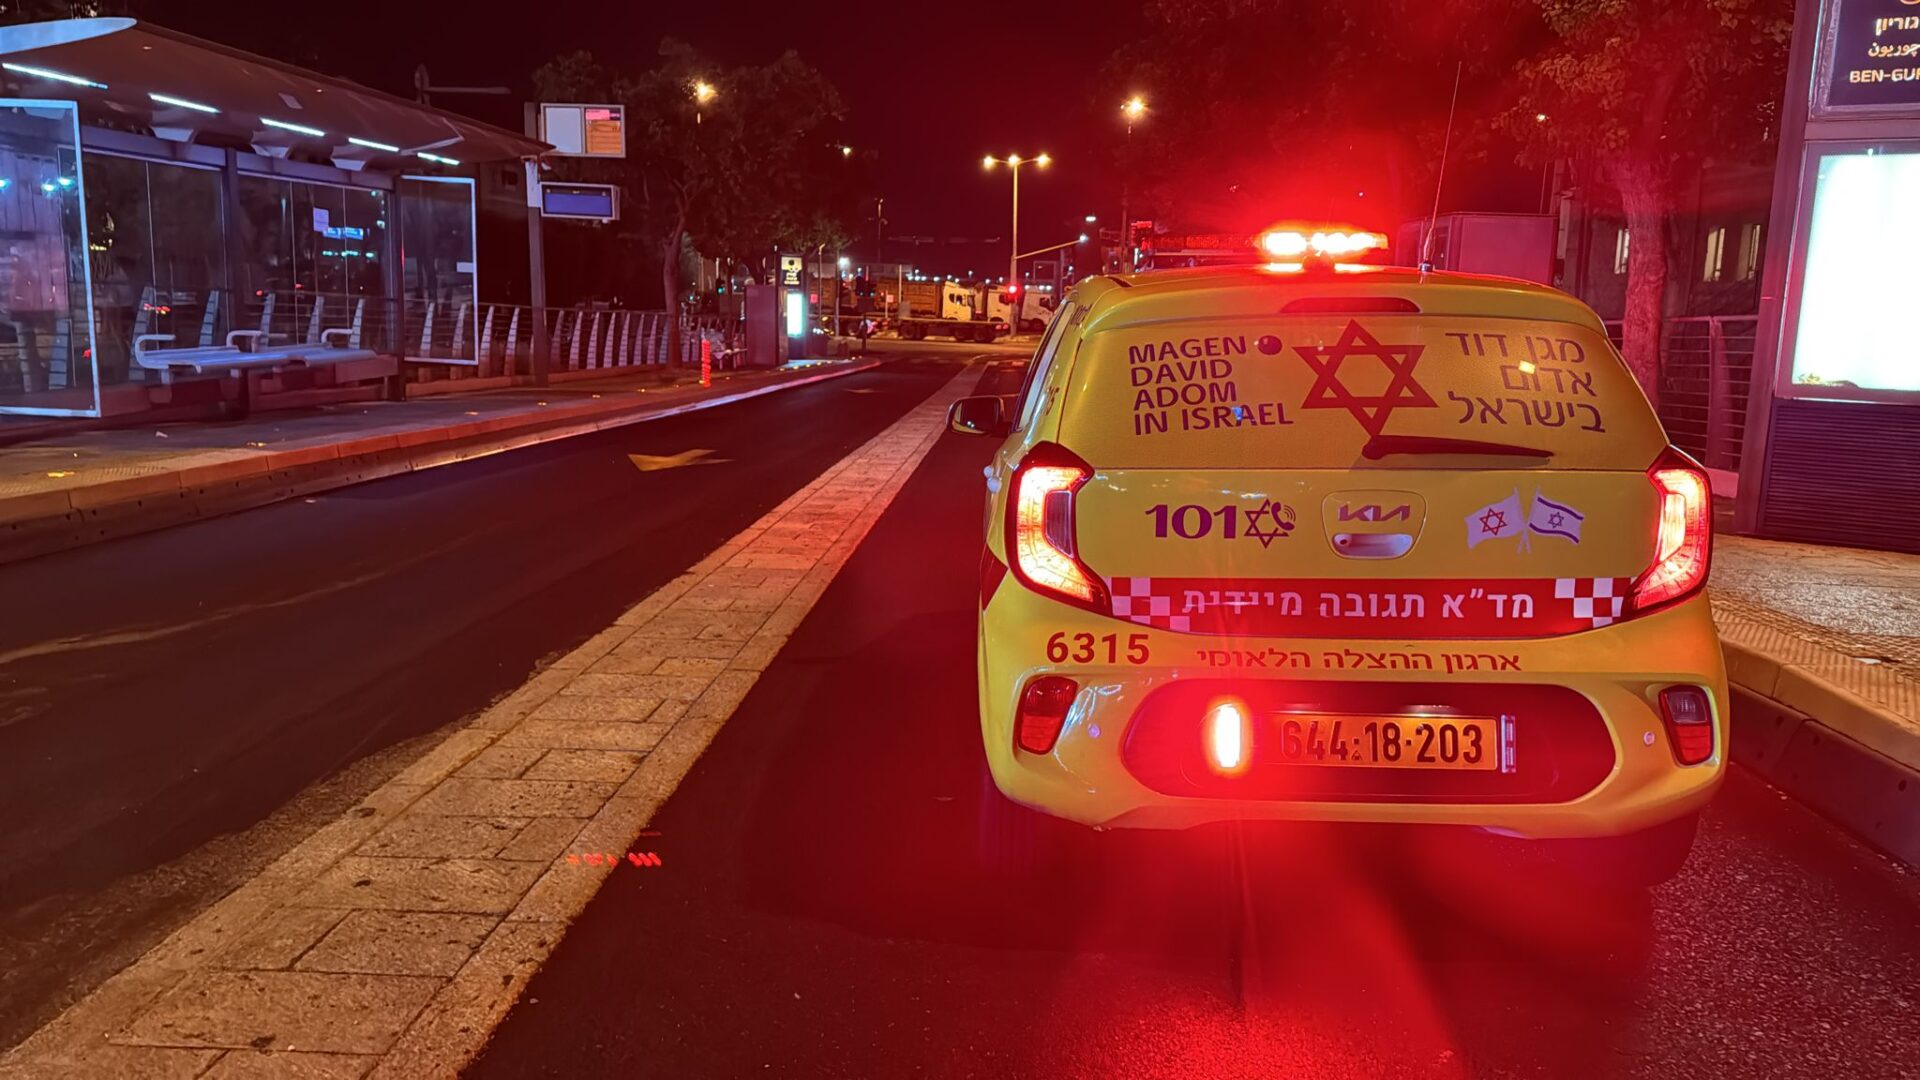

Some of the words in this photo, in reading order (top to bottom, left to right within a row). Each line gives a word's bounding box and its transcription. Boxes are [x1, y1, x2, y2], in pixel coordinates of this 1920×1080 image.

[1875, 16, 1919, 36] גוריון
[1128, 335, 1247, 364] MAGEN
[1445, 332, 1509, 358] דוד
[1525, 335, 1586, 365] מגן
[1130, 358, 1233, 387] DAVID
[1500, 364, 1598, 397] אדום
[1133, 381, 1237, 411] ADOM
[1133, 411, 1168, 436] IN
[1181, 402, 1294, 431] ISRAEL
[1447, 390, 1606, 433] בישראל
[1145, 504, 1237, 539] 101
[1338, 503, 1411, 522] KIA
[1182, 590, 1303, 616] מיידית
[1319, 592, 1425, 618] תגובה
[1046, 631, 1150, 665] 6315
[1196, 648, 1311, 669] הלאומי
[1323, 649, 1433, 670] ההצלה
[1441, 653, 1522, 674] ארגון
